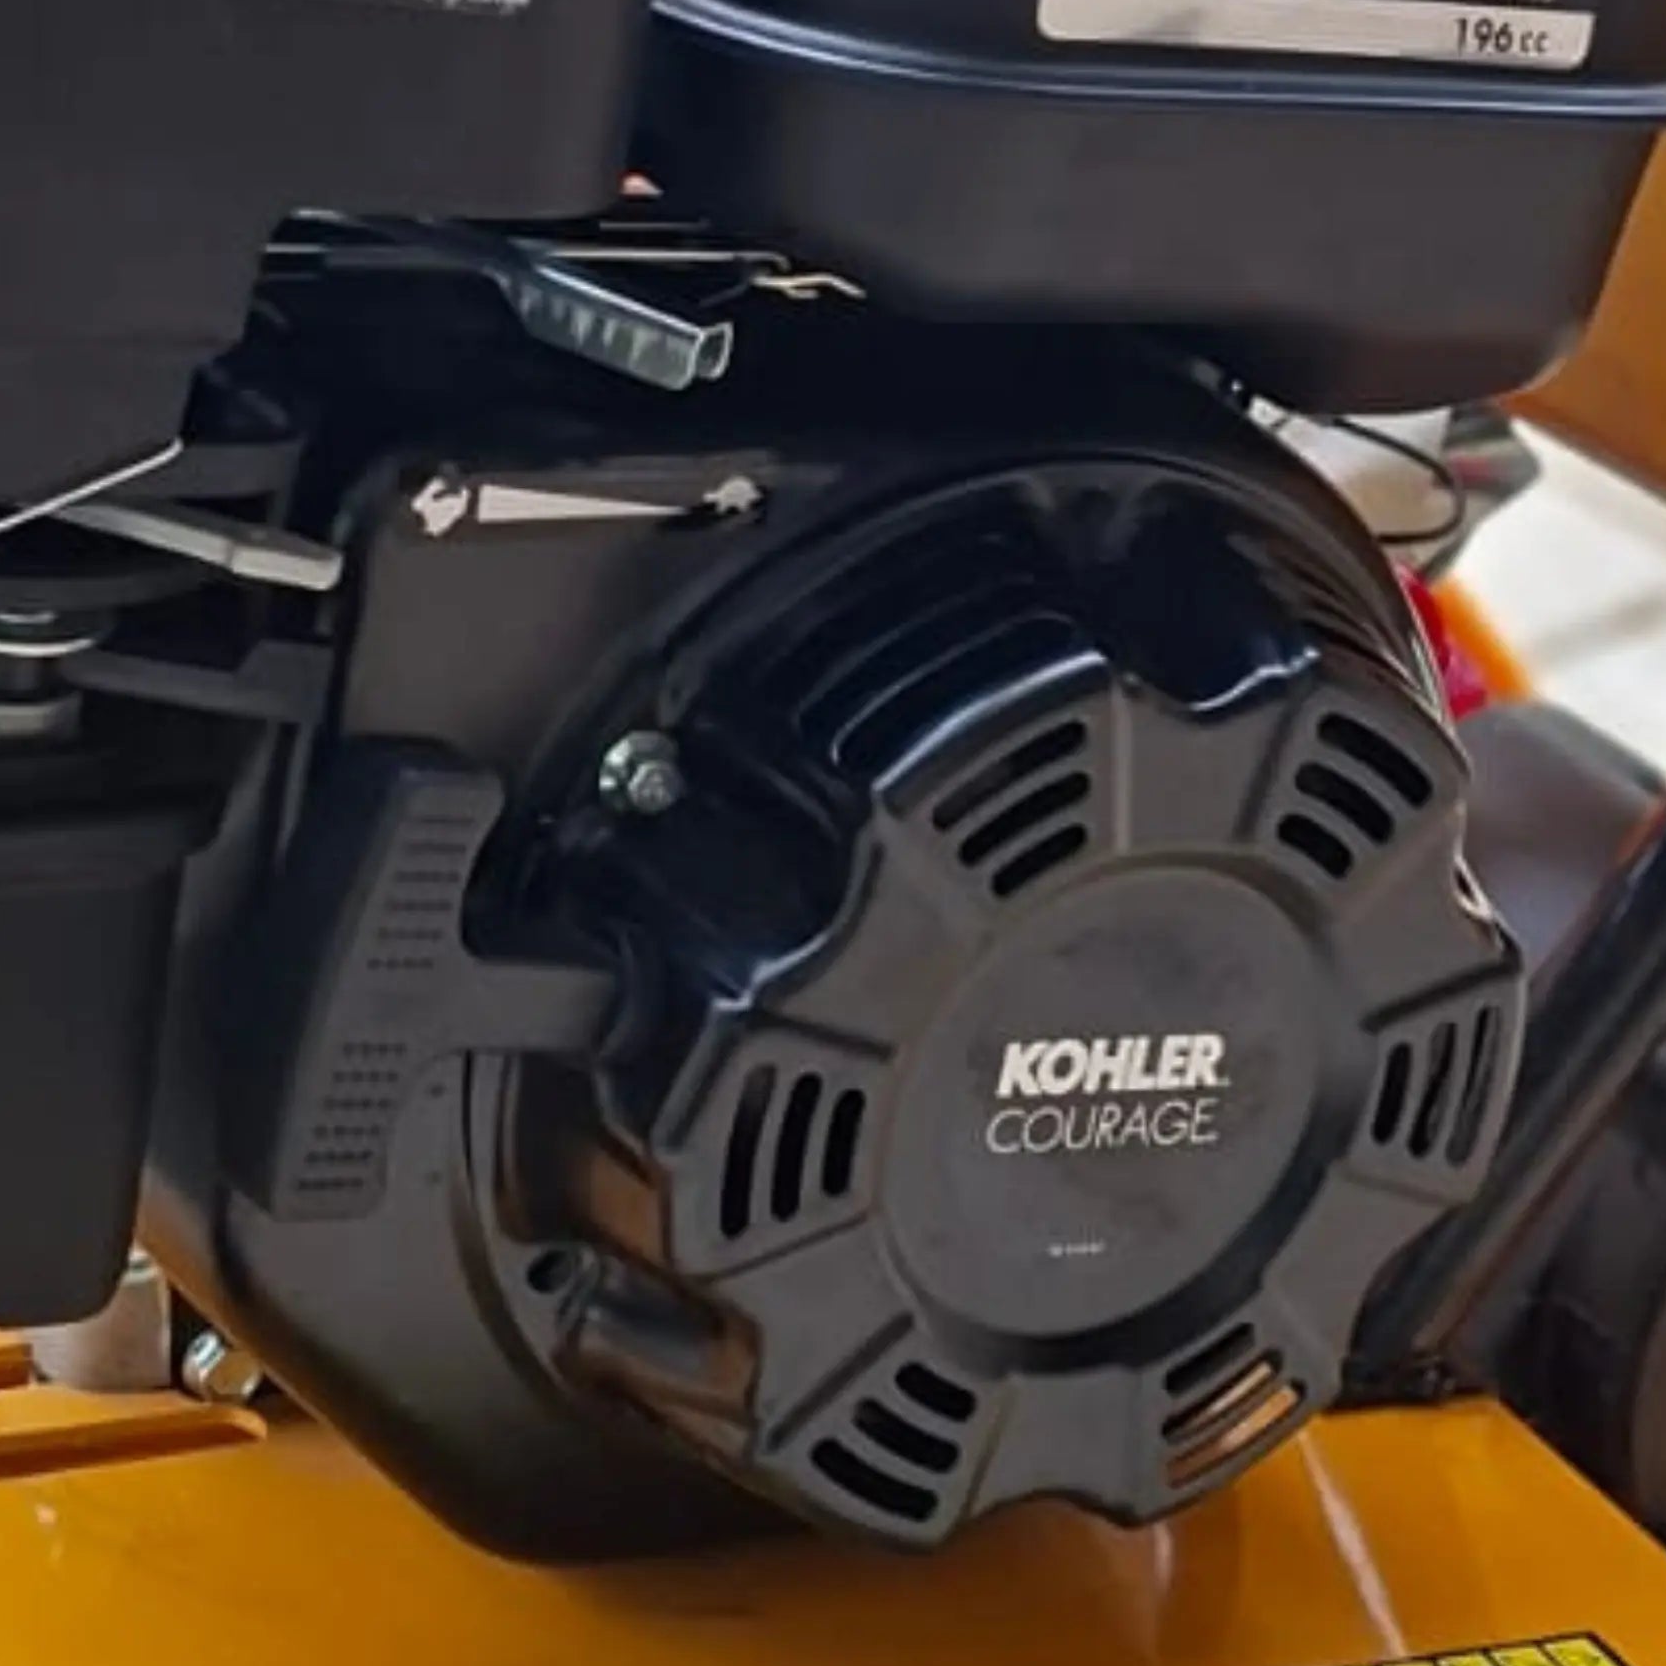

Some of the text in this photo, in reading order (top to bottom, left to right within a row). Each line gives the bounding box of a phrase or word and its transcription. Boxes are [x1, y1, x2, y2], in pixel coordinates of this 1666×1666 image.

[1454, 15, 1513, 56] 196
[995, 1033, 1226, 1099] KOHLER
[986, 1098, 1220, 1154] COURAGE
